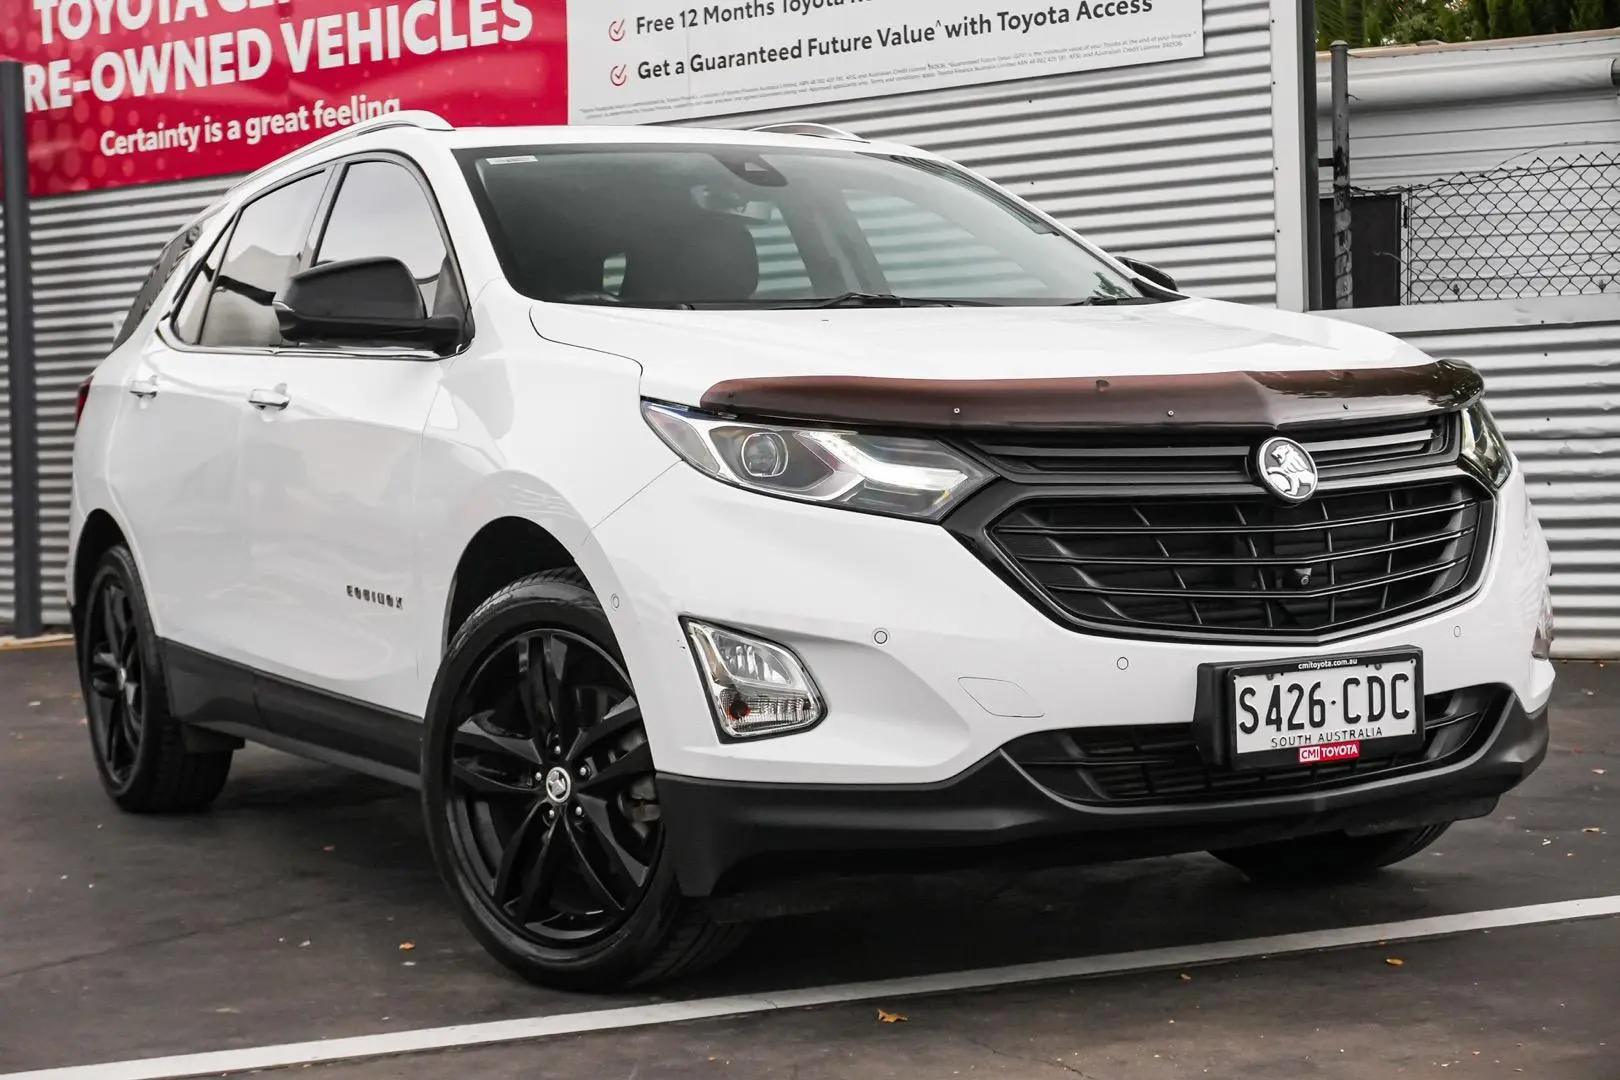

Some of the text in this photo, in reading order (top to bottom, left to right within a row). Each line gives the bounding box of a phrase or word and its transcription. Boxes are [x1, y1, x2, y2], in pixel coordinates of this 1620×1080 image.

[636, 15, 674, 35] Free
[680, 10, 698, 28] 12
[703, 2, 774, 25] Months
[637, 58, 670, 79] Get
[675, 60, 685, 74] a
[690, 39, 802, 73] Guaranteed
[808, 35, 873, 57] Future
[945, 15, 991, 38] with
[997, 7, 1070, 34] Toyota
[1076, 0, 1153, 21] Access
[23, 0, 532, 113] RE-OWNED VEHICLES
[100, 119, 199, 156] Certainty
[204, 115, 222, 140] is
[227, 118, 240, 139] a
[245, 105, 310, 143] great
[1298, 658, 1358, 670] cmitoyota.com.au
[1271, 727, 1383, 748] SOUTH AUSTRALIA
[1301, 744, 1359, 760] CMI TOYOTA
